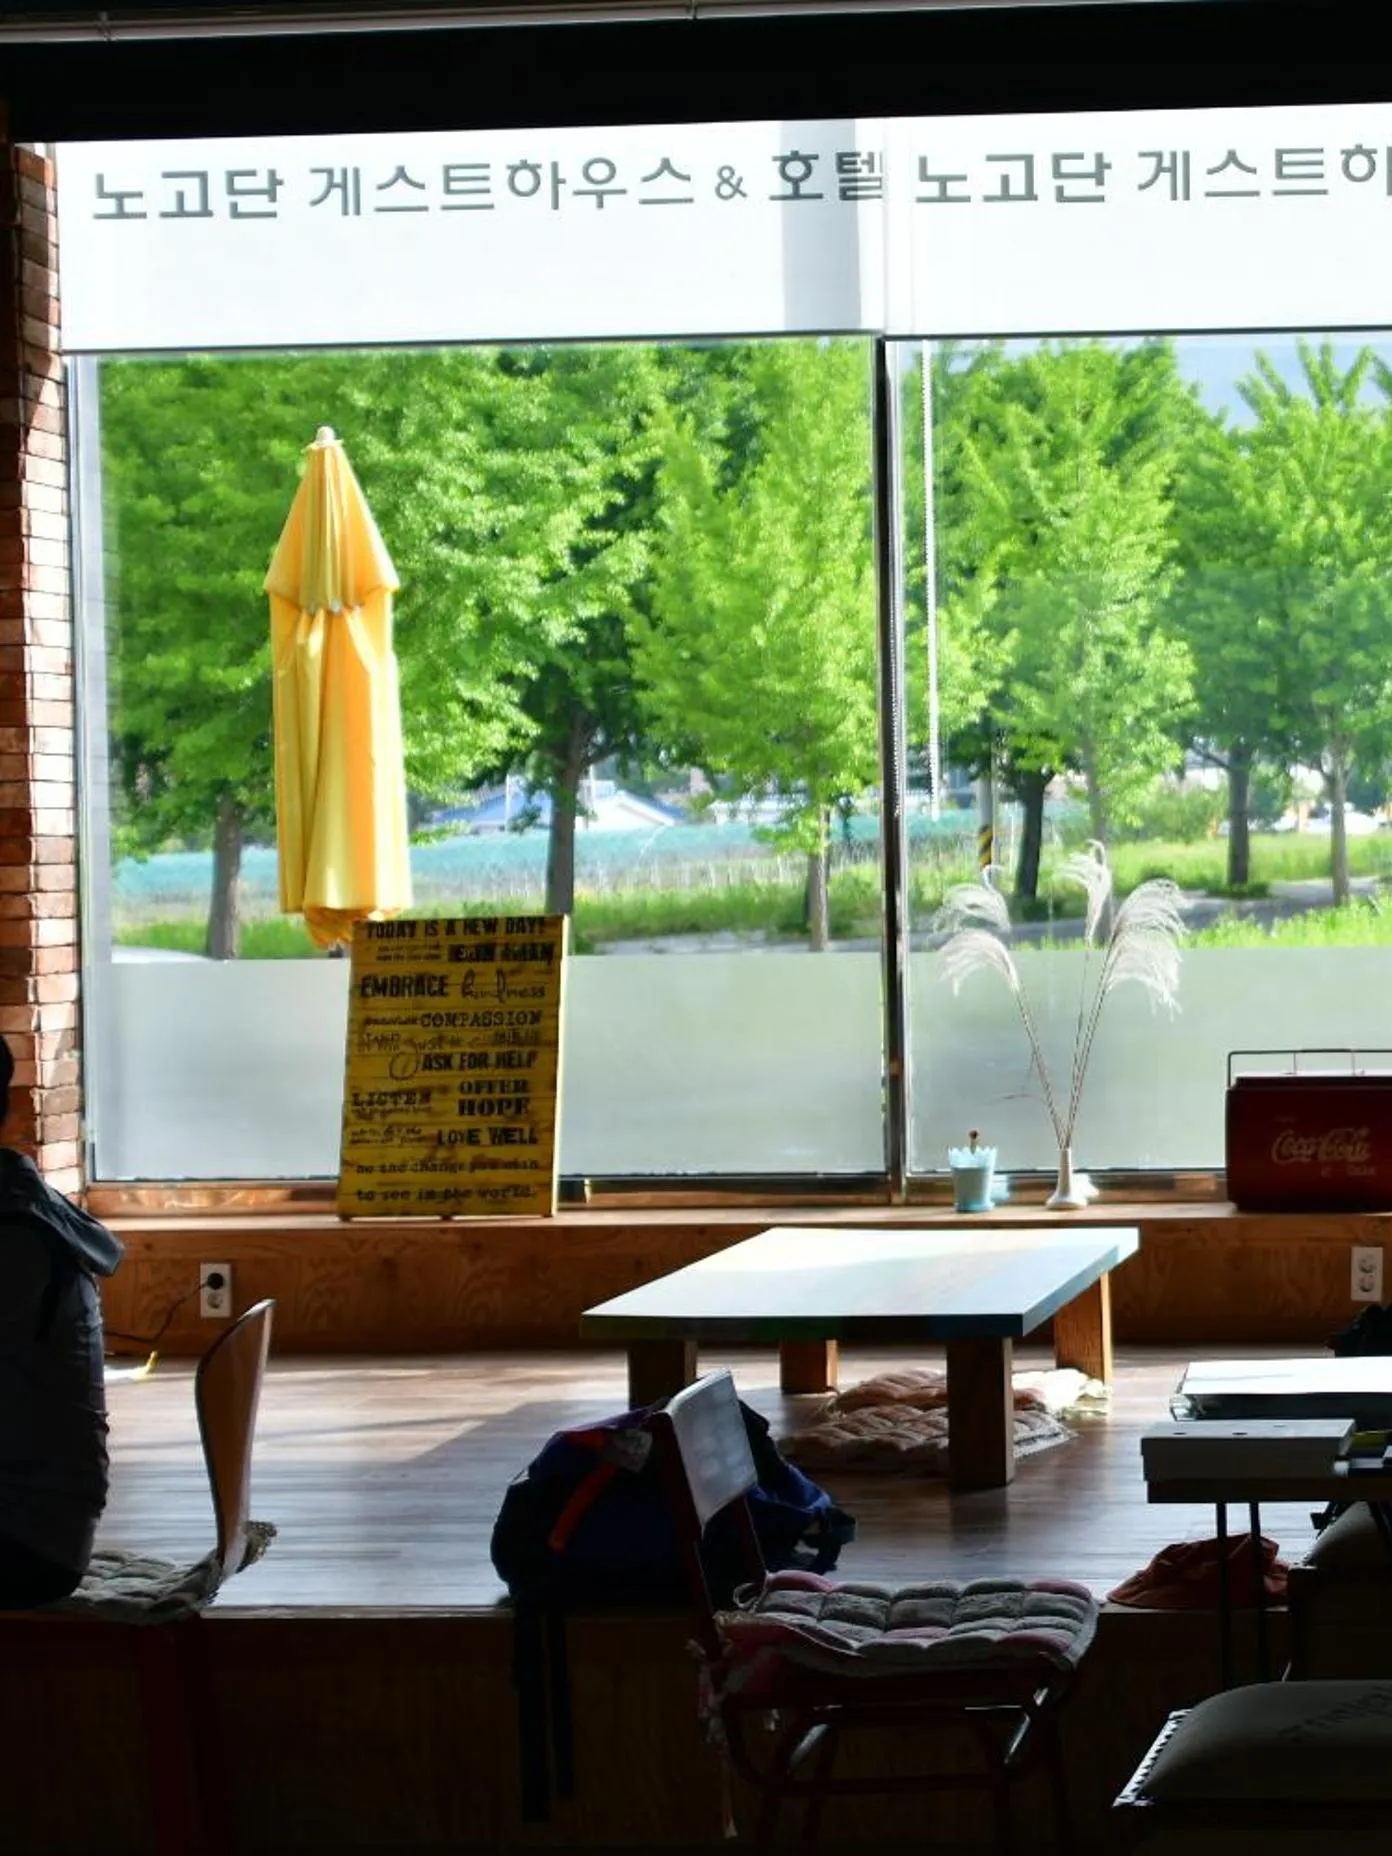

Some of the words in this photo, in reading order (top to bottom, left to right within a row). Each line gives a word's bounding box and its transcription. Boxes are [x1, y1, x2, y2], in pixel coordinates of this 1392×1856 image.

[93, 169, 284, 219] 노고단
[310, 156, 694, 216] 게스트하우스
[715, 165, 747, 200] &
[769, 150, 883, 201] 호텔
[916, 152, 1112, 203] 노고단
[367, 919, 417, 939] TODAY
[425, 918, 438, 937] IS
[446, 917, 460, 936] A
[463, 916, 497, 935] NEW
[360, 974, 448, 998] EMBRACE
[420, 1010, 543, 1028] COMPASSION
[421, 1052, 453, 1071] ASK
[459, 1051, 492, 1070] FOR
[495, 1050, 538, 1069] HELP
[458, 1098, 531, 1117] HOPE
[488, 1126, 538, 1145] WELL
